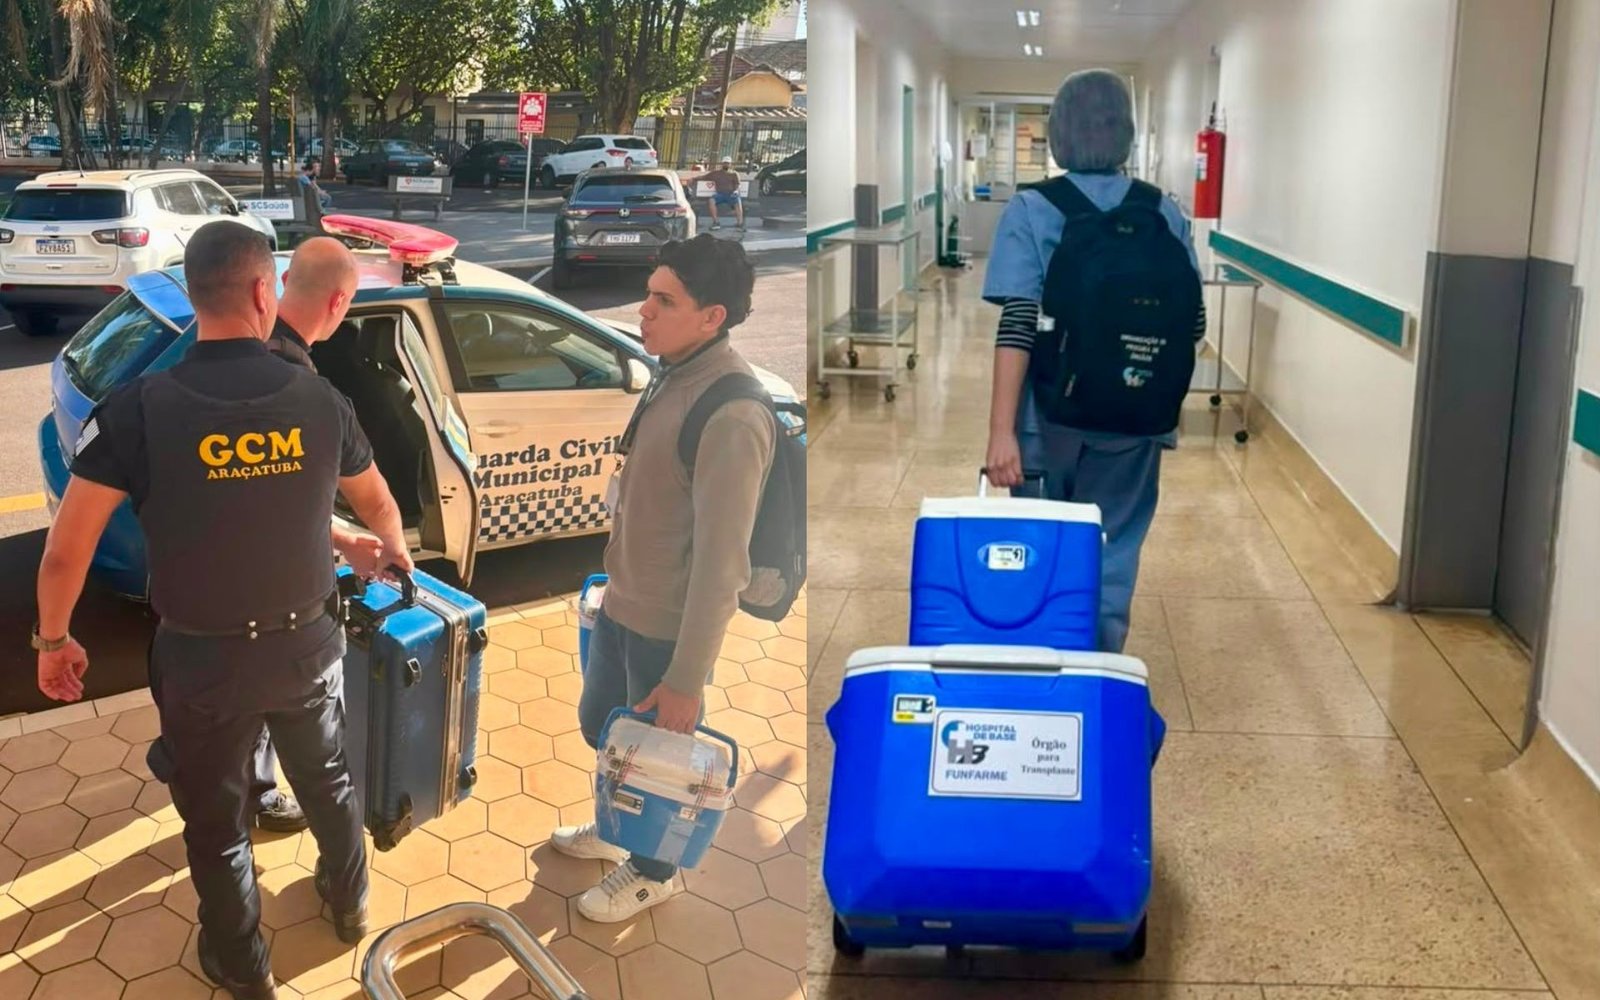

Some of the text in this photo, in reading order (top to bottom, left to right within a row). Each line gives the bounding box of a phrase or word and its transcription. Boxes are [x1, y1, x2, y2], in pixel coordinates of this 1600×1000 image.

[199, 428, 304, 466] GCM
[477, 435, 623, 469] uarda Civil
[207, 461, 302, 480] ARAÇATUBA
[473, 458, 603, 490] Municipal
[479, 485, 582, 507] Araçatuba
[966, 724, 1016, 733] HOSPITAL
[973, 732, 1016, 741] DE BASE
[1031, 737, 1067, 752] Órgão
[1037, 752, 1060, 762] para
[945, 769, 1008, 781] FUNFARME
[1021, 765, 1076, 776] Transplante
